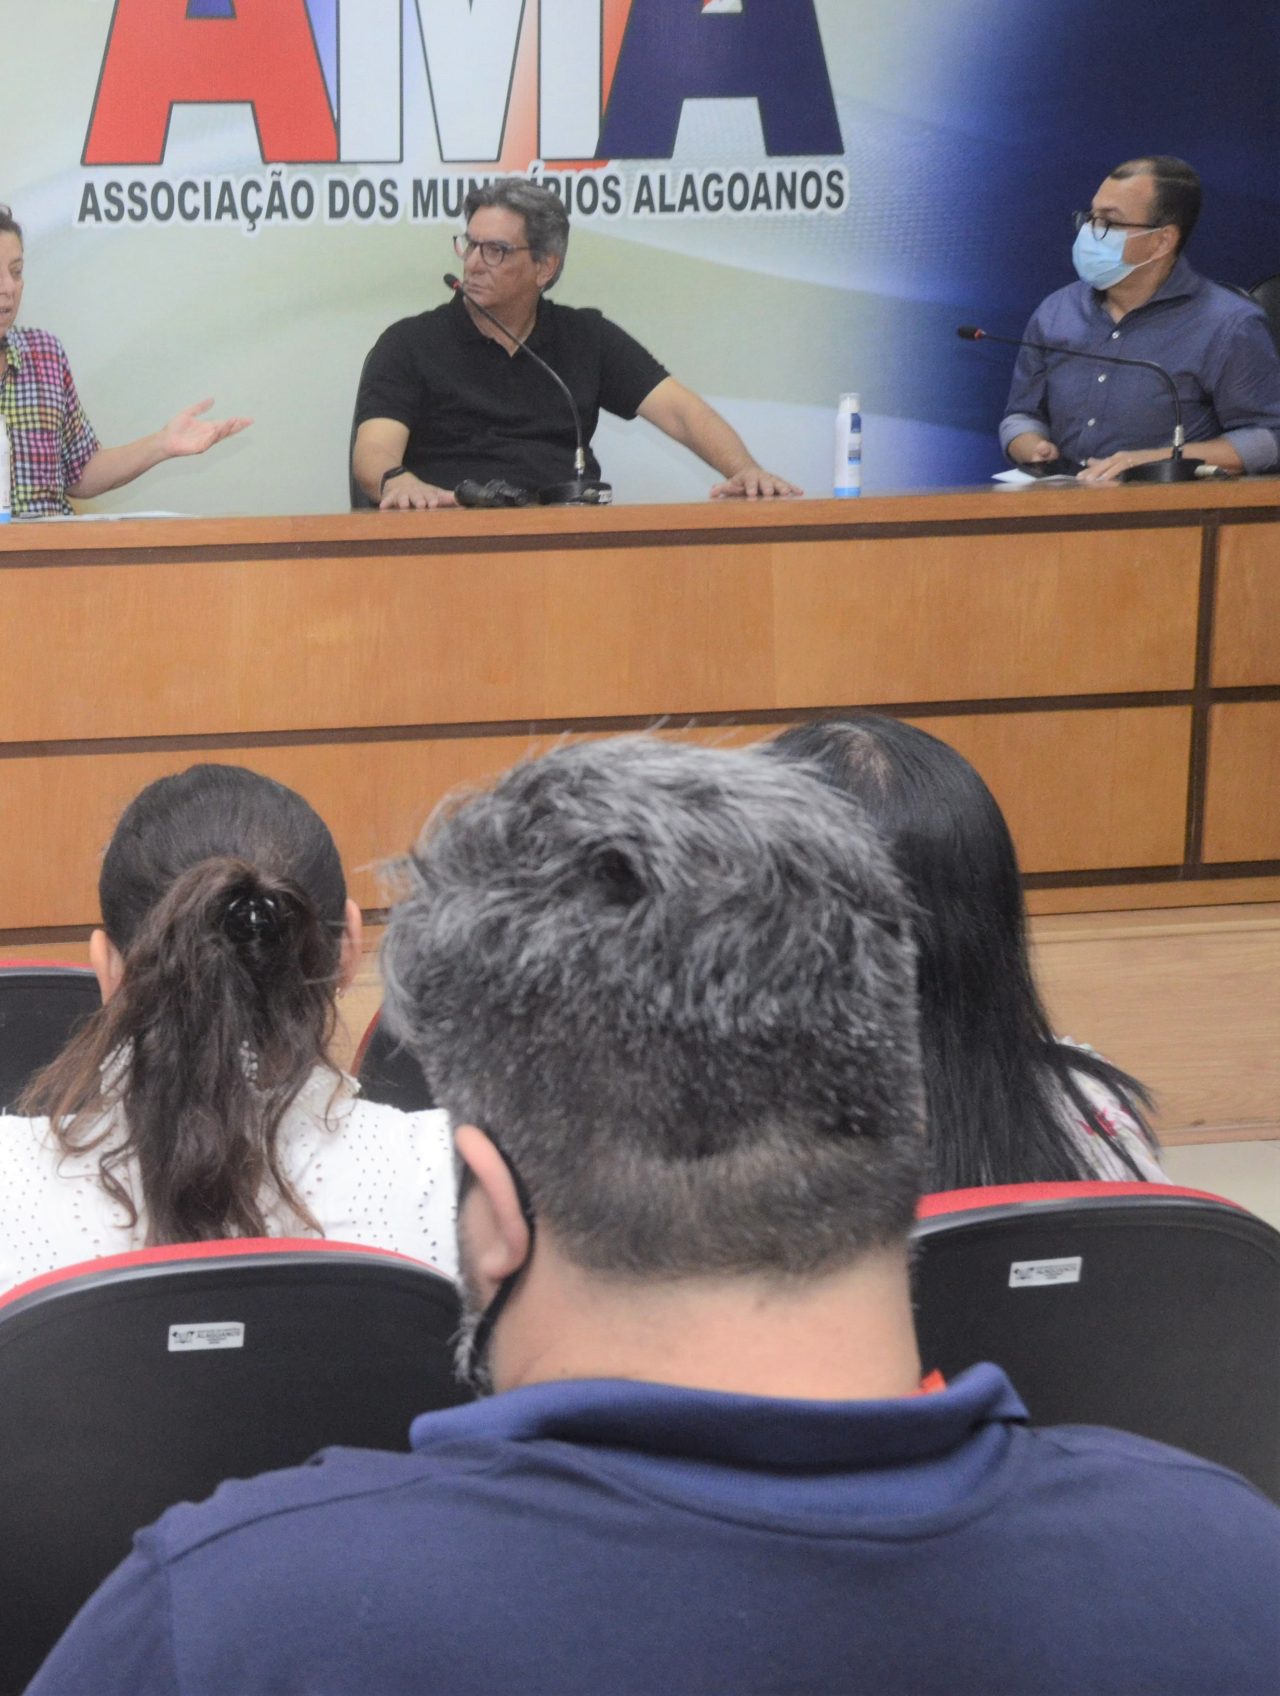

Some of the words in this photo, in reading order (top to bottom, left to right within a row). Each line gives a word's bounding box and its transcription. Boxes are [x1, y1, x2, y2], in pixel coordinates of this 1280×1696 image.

[77, 169, 315, 231] ASSOCIAÇÃO
[328, 179, 400, 219] DOS
[412, 166, 620, 218] MUPIOS
[632, 169, 845, 215] ALAGOANOS
